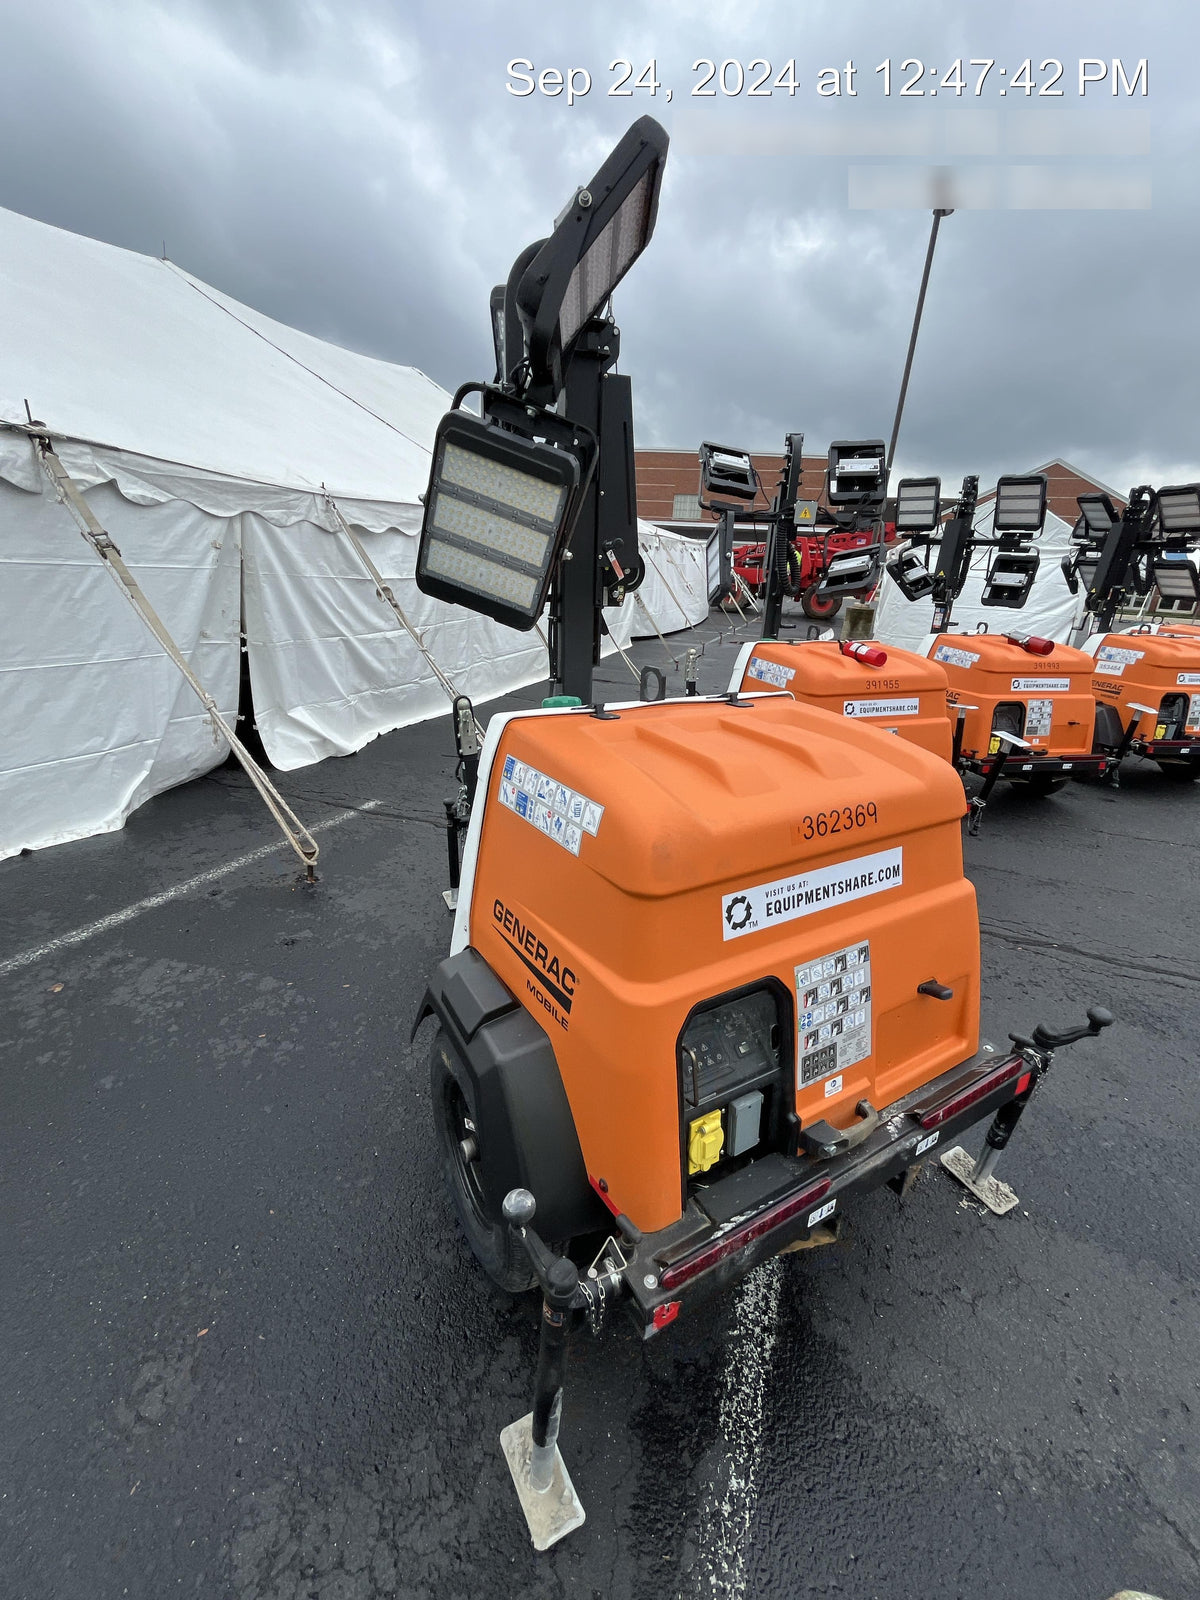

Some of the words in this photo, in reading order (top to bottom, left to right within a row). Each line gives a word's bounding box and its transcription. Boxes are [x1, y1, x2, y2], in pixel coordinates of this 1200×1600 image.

[865, 679, 900, 690] 391955
[1091, 679, 1125, 691] ENERAC
[859, 704, 918, 714] EQUIPMENTSHARE.COM
[801, 801, 878, 840] 362369
[764, 887, 785, 899] VISIT
[786, 883, 797, 893] US
[798, 880, 810, 890] AT:
[765, 863, 901, 917] EQUIPMENTSHARE.COM
[493, 898, 577, 997] GENERAC
[526, 978, 569, 1032] MOBILE
